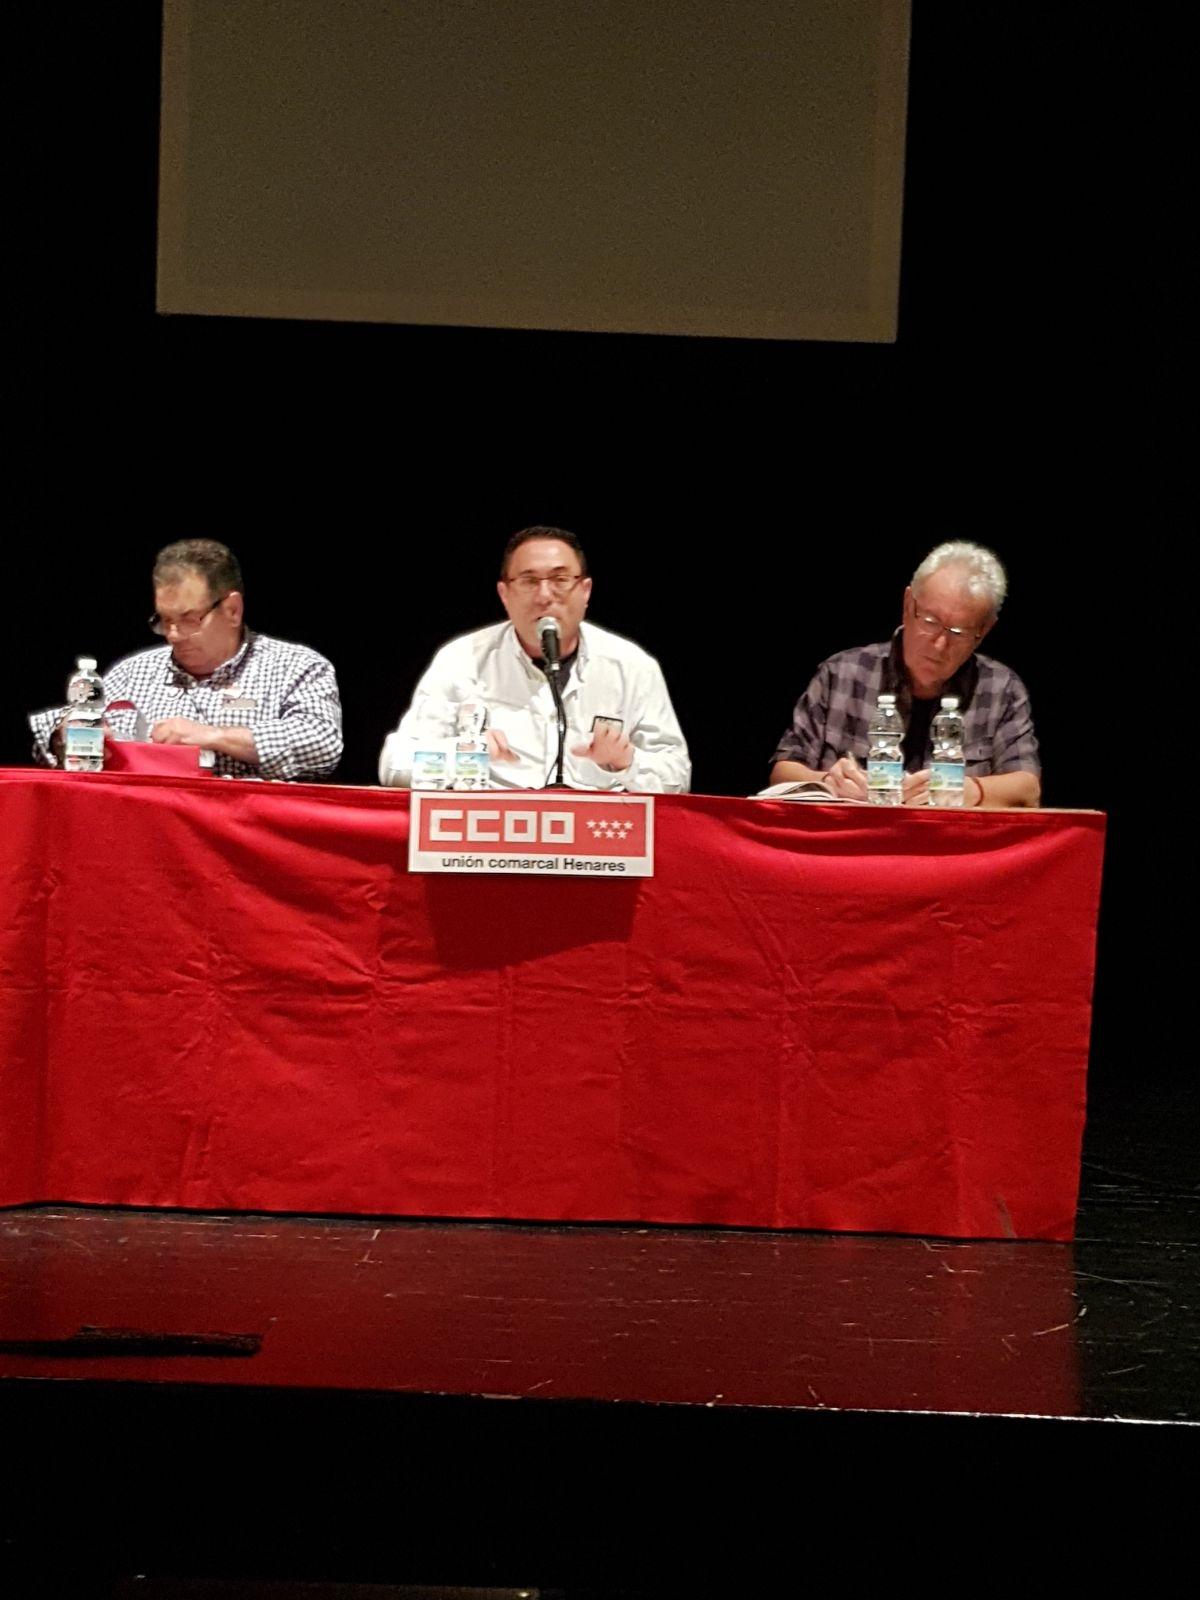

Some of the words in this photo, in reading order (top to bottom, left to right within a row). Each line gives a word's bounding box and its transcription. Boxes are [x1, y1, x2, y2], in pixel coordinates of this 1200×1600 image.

[429, 809, 576, 844] CCOO
[442, 857, 484, 868] unión
[489, 858, 559, 870] comarcal
[563, 858, 626, 872] Henares
